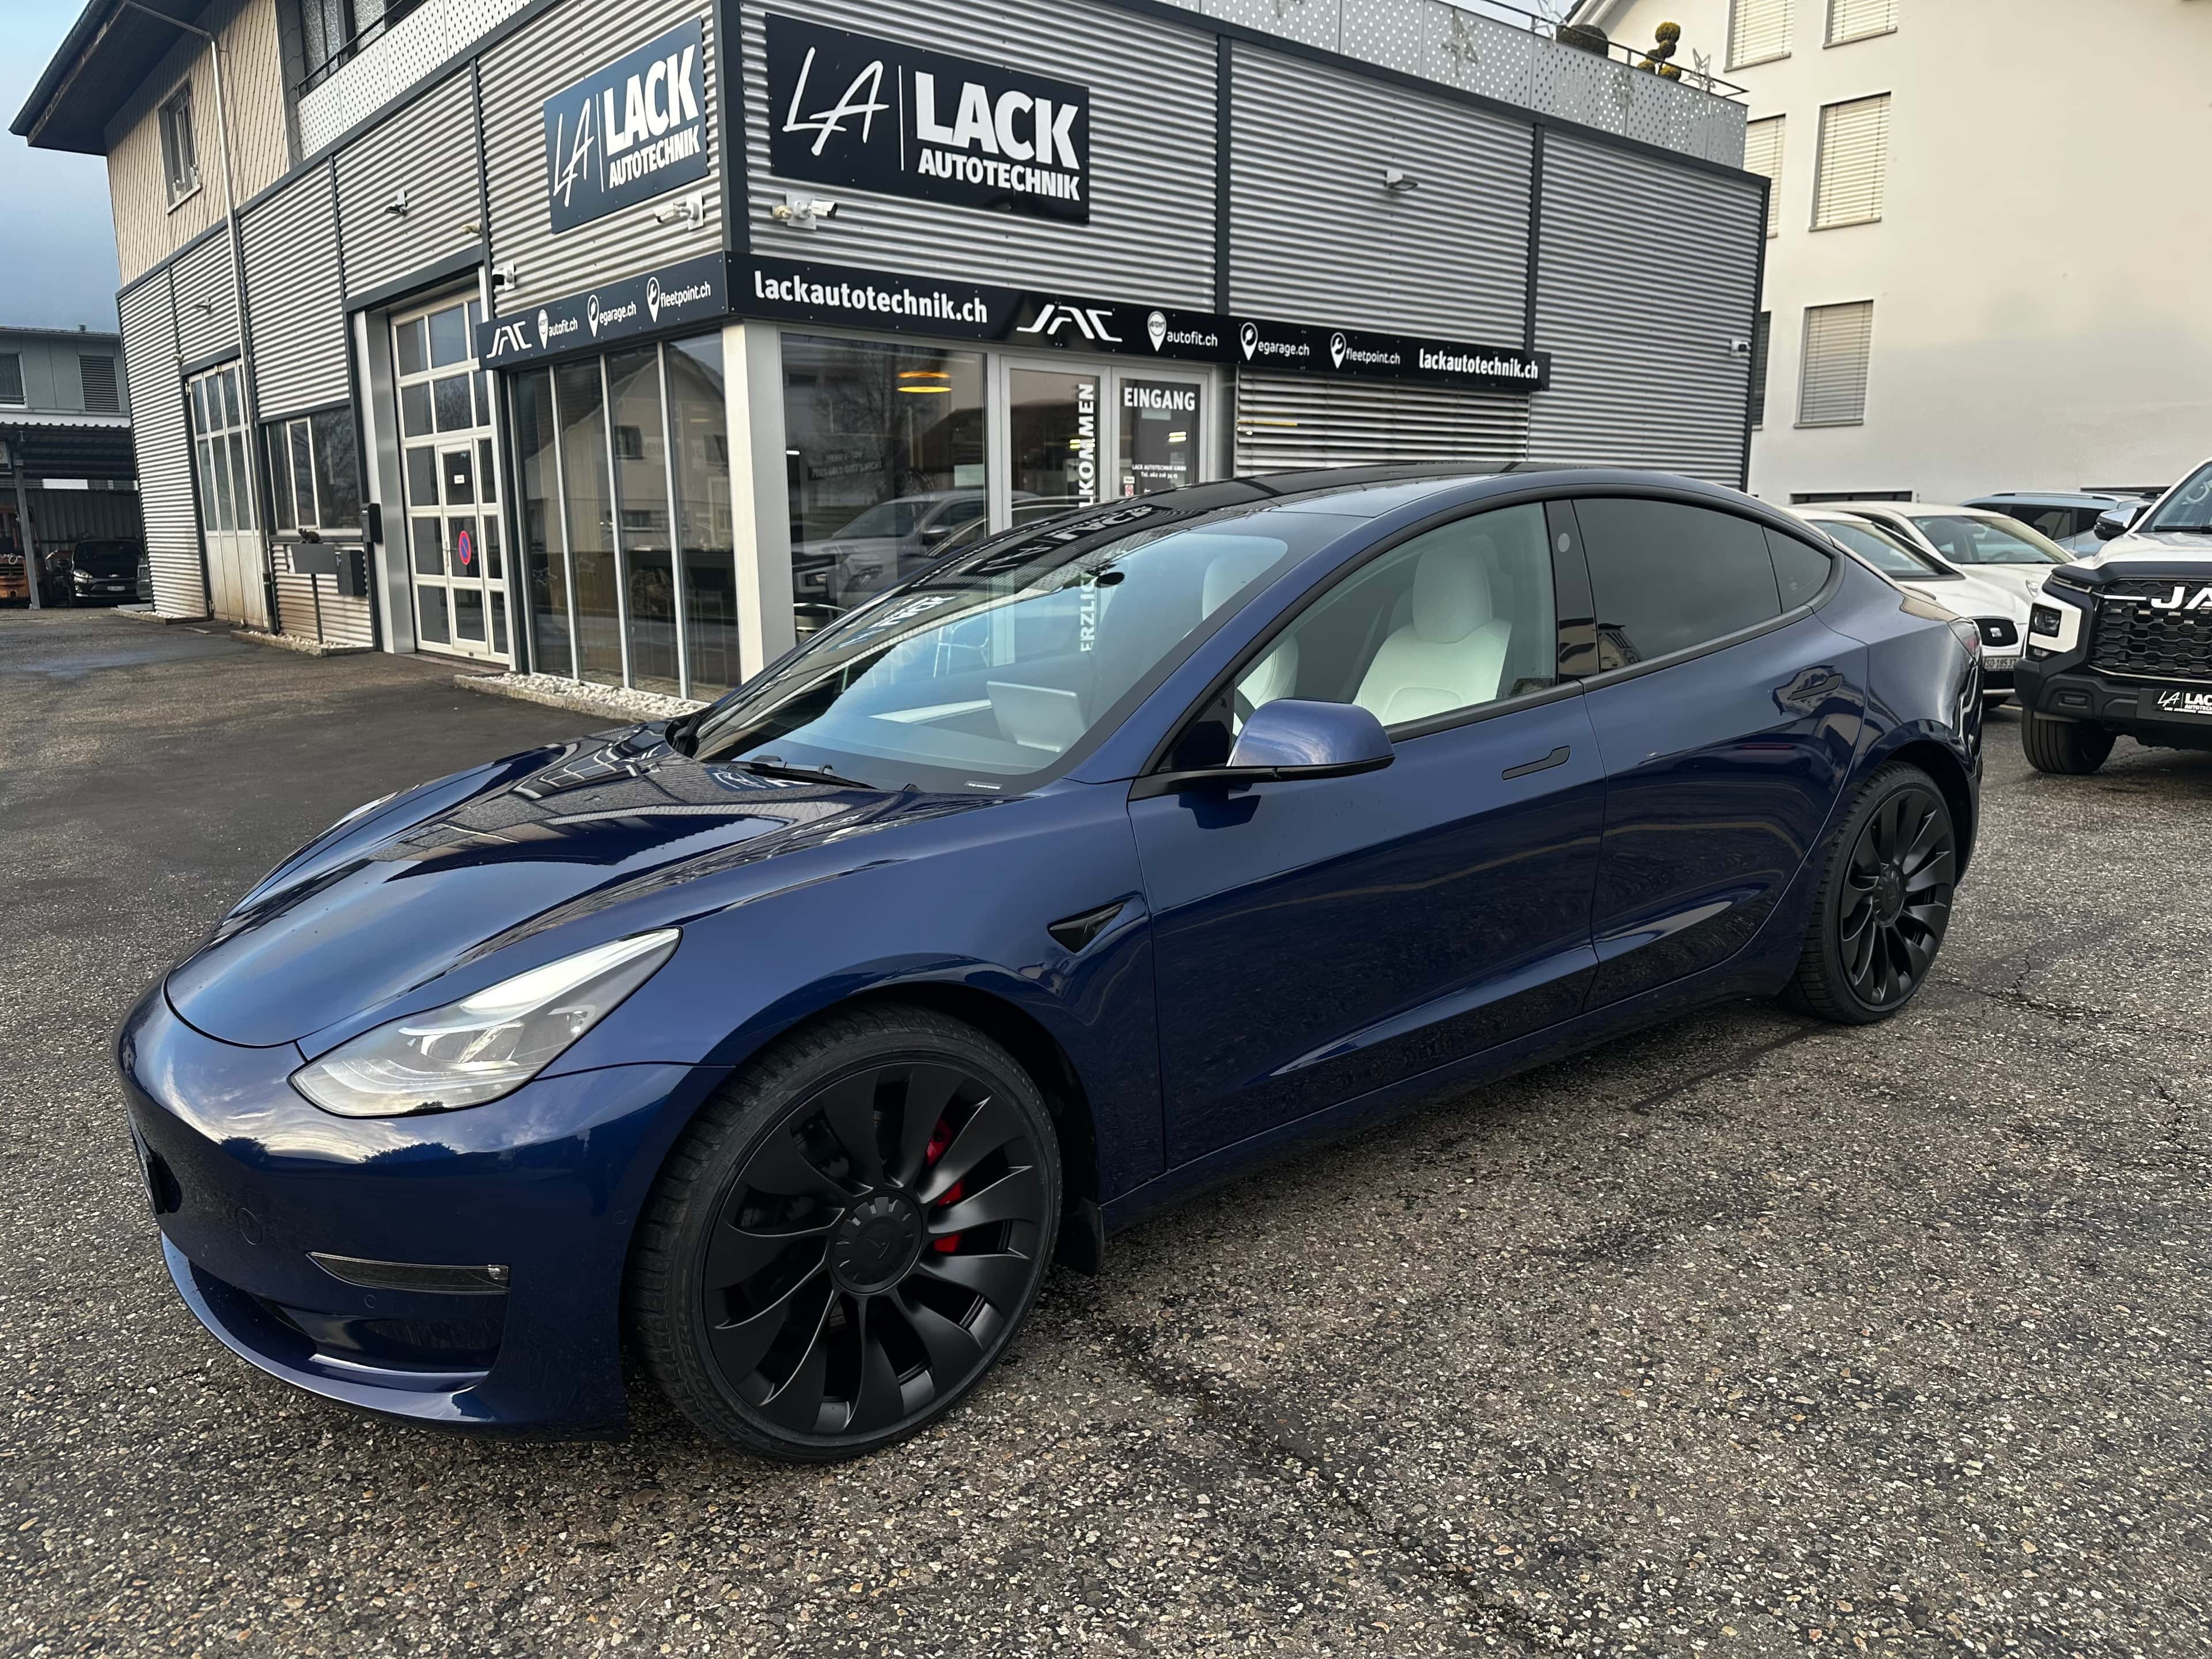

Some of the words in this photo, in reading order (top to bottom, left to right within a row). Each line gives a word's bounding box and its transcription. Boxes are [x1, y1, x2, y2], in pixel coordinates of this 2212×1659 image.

[603, 44, 699, 157] LACK
[915, 71, 1080, 169] LACK
[609, 124, 701, 189] AUTOTECHNIK
[918, 148, 1080, 200] AUTOTECHNIK
[660, 281, 711, 308] fleetpoint.ch
[754, 270, 987, 323] lackautotechnik.ch
[599, 301, 637, 325] egarage.ch
[549, 319, 578, 336] autofit.ch
[1167, 330, 1218, 347] autofit.ch
[1258, 340, 1309, 358] egarage.ch
[1346, 347, 1400, 365] fleetpoint.ch
[1419, 349, 1539, 379] lackautotechnik.ch
[1124, 387, 1195, 411] EINGANG
